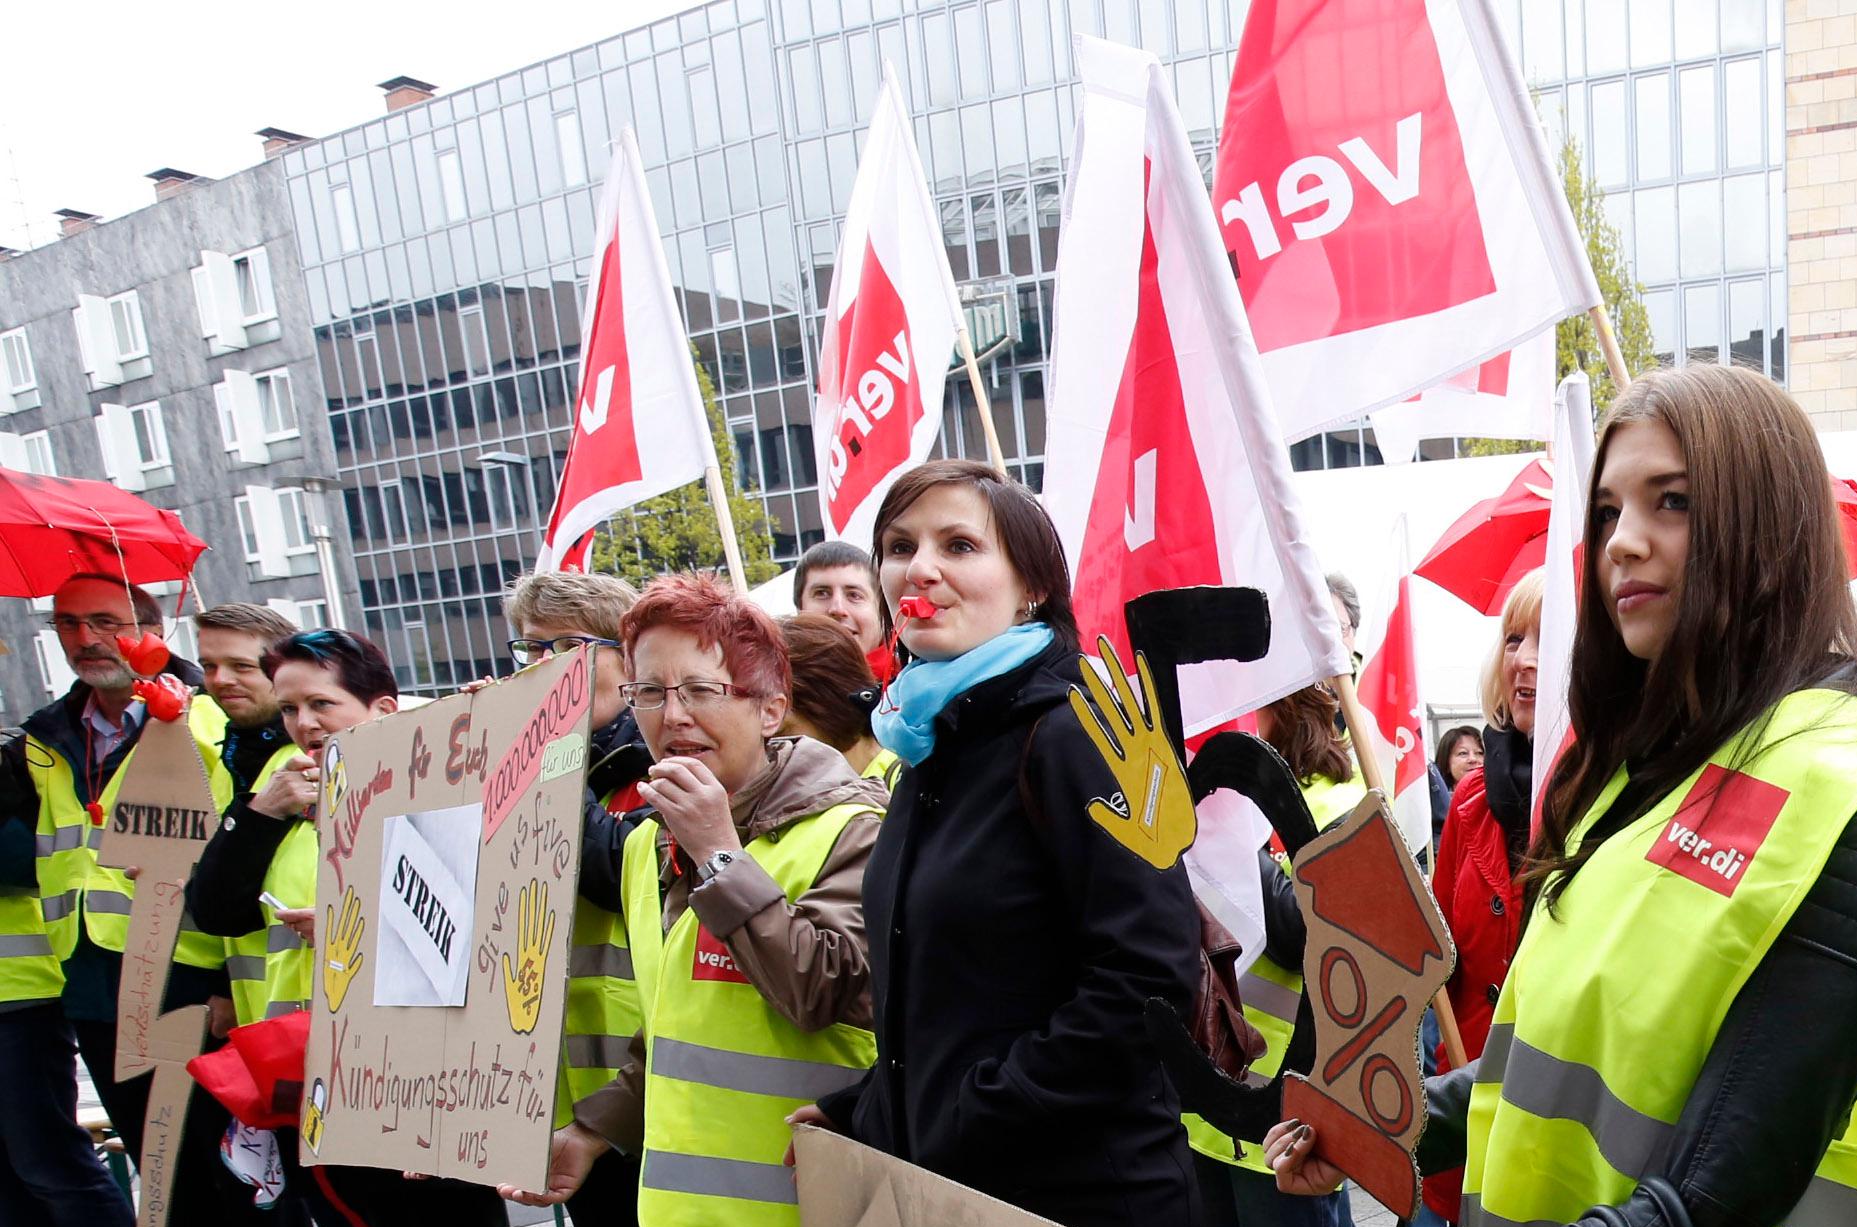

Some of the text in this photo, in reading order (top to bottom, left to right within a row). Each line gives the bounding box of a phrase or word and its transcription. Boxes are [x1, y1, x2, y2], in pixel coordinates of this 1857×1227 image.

[113, 802, 209, 842] STREIK
[1666, 820, 1747, 882] ver.di
[392, 853, 457, 967] STREIK
[698, 949, 739, 972] ver.
[326, 1014, 514, 1149] Kündigungsschutz
[457, 1129, 489, 1169] uns
